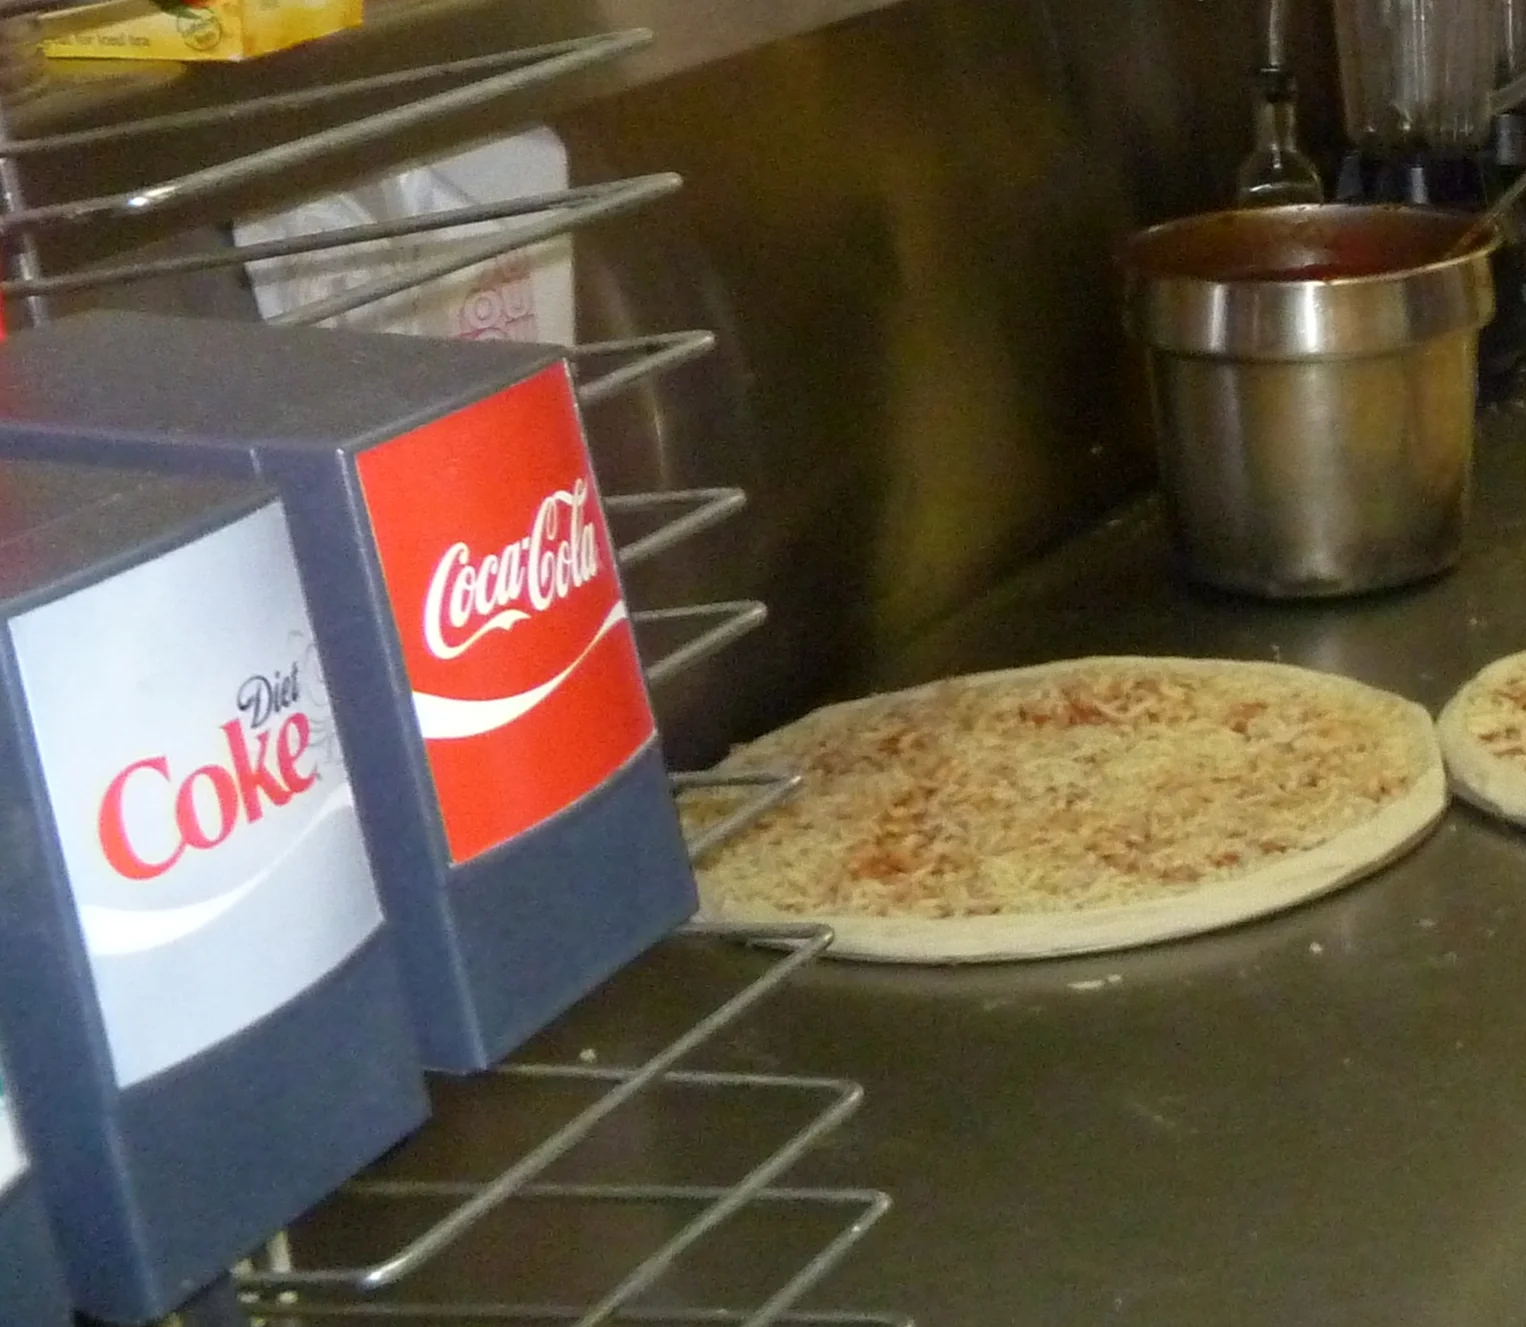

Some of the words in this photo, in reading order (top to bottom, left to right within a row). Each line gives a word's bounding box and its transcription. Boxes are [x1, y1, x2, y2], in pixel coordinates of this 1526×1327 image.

[424, 478, 600, 660] Coca-Cola
[236, 661, 299, 728] Diet
[97, 712, 318, 881] Coke
